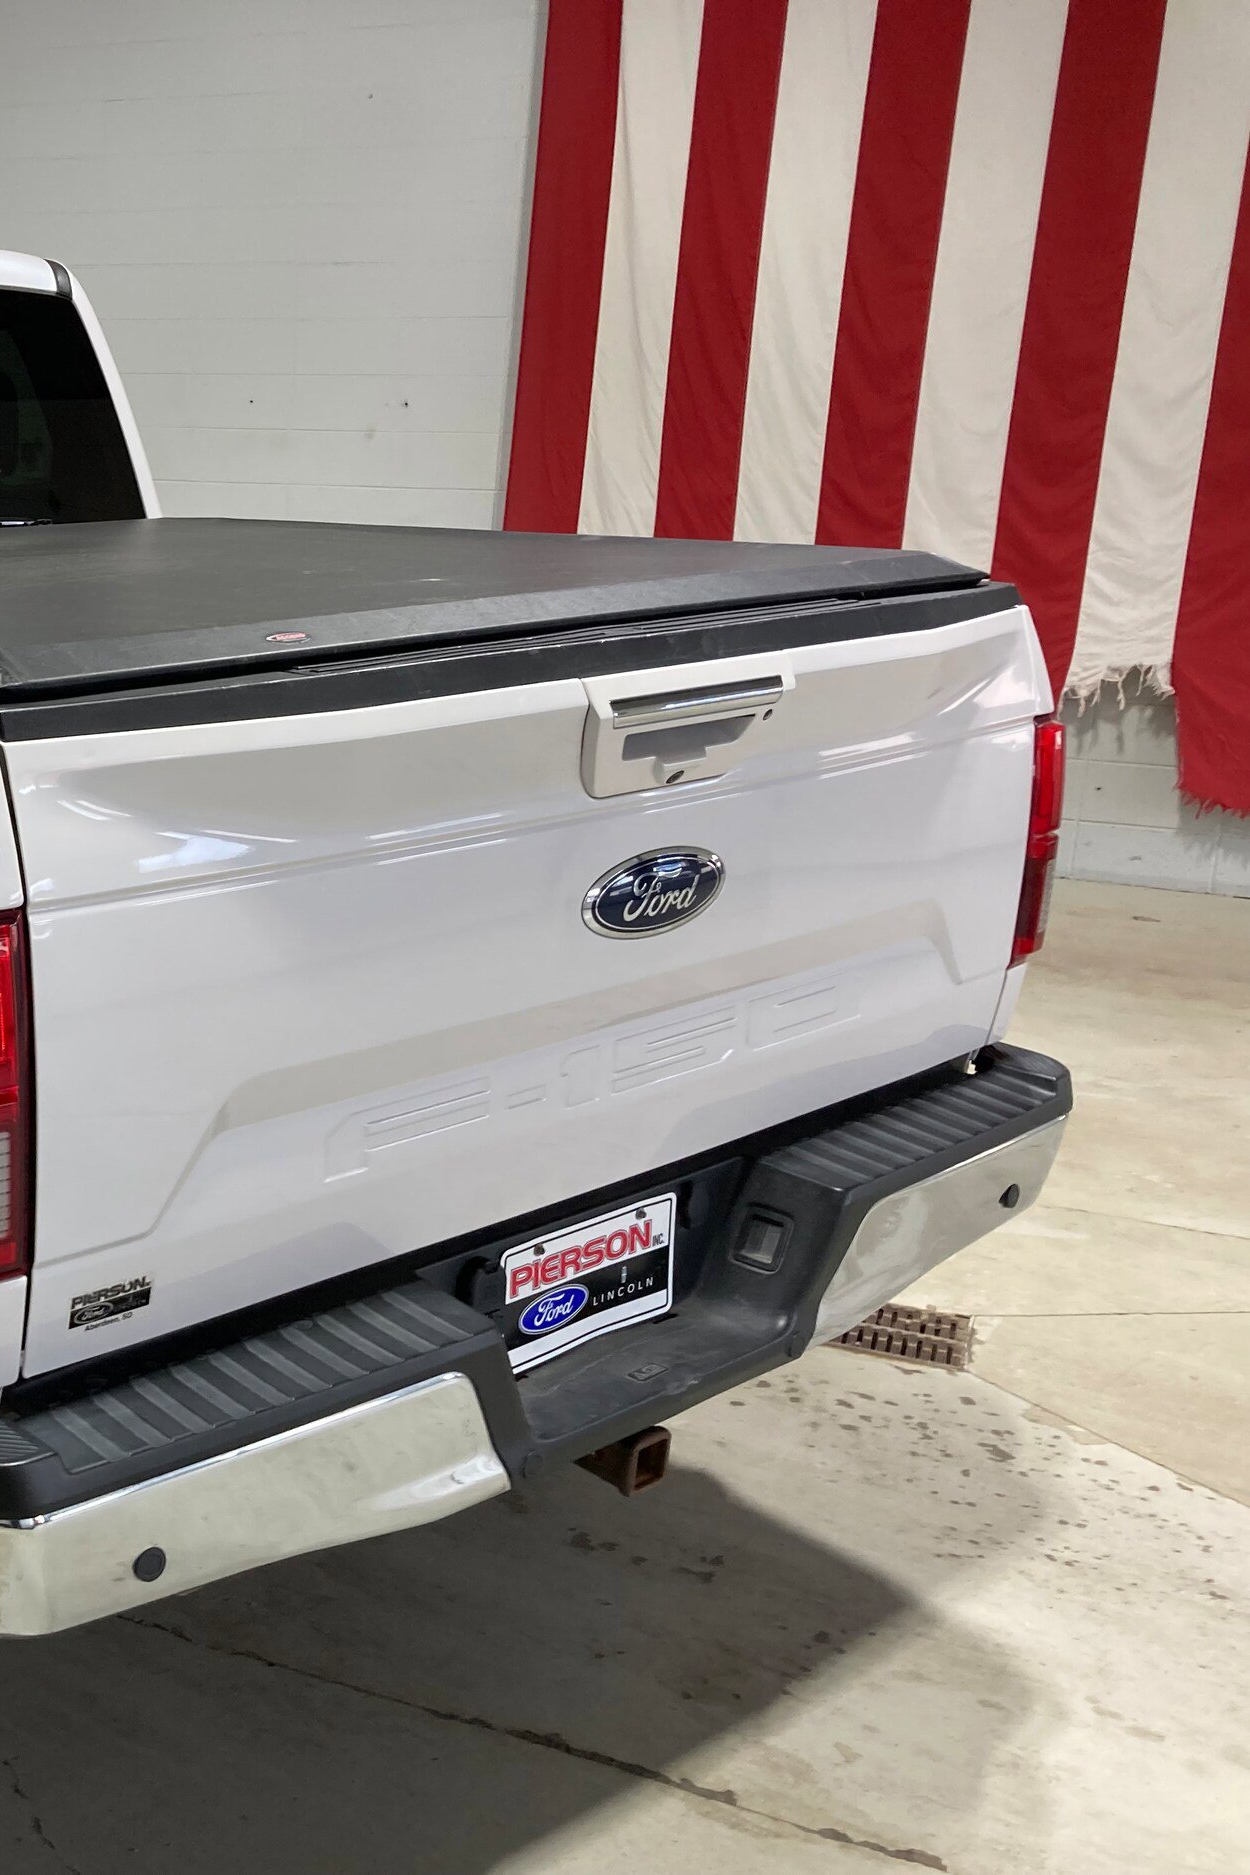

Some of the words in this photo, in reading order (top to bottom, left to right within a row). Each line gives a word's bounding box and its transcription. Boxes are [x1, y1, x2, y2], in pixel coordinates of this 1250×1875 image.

[622, 866, 700, 922] Ford
[323, 971, 862, 1183] F-150
[509, 1218, 653, 1299] PIERSON
[71, 1275, 147, 1310] PIERSON
[533, 1292, 575, 1327] Ford
[592, 1276, 654, 1306] LINCOLN
